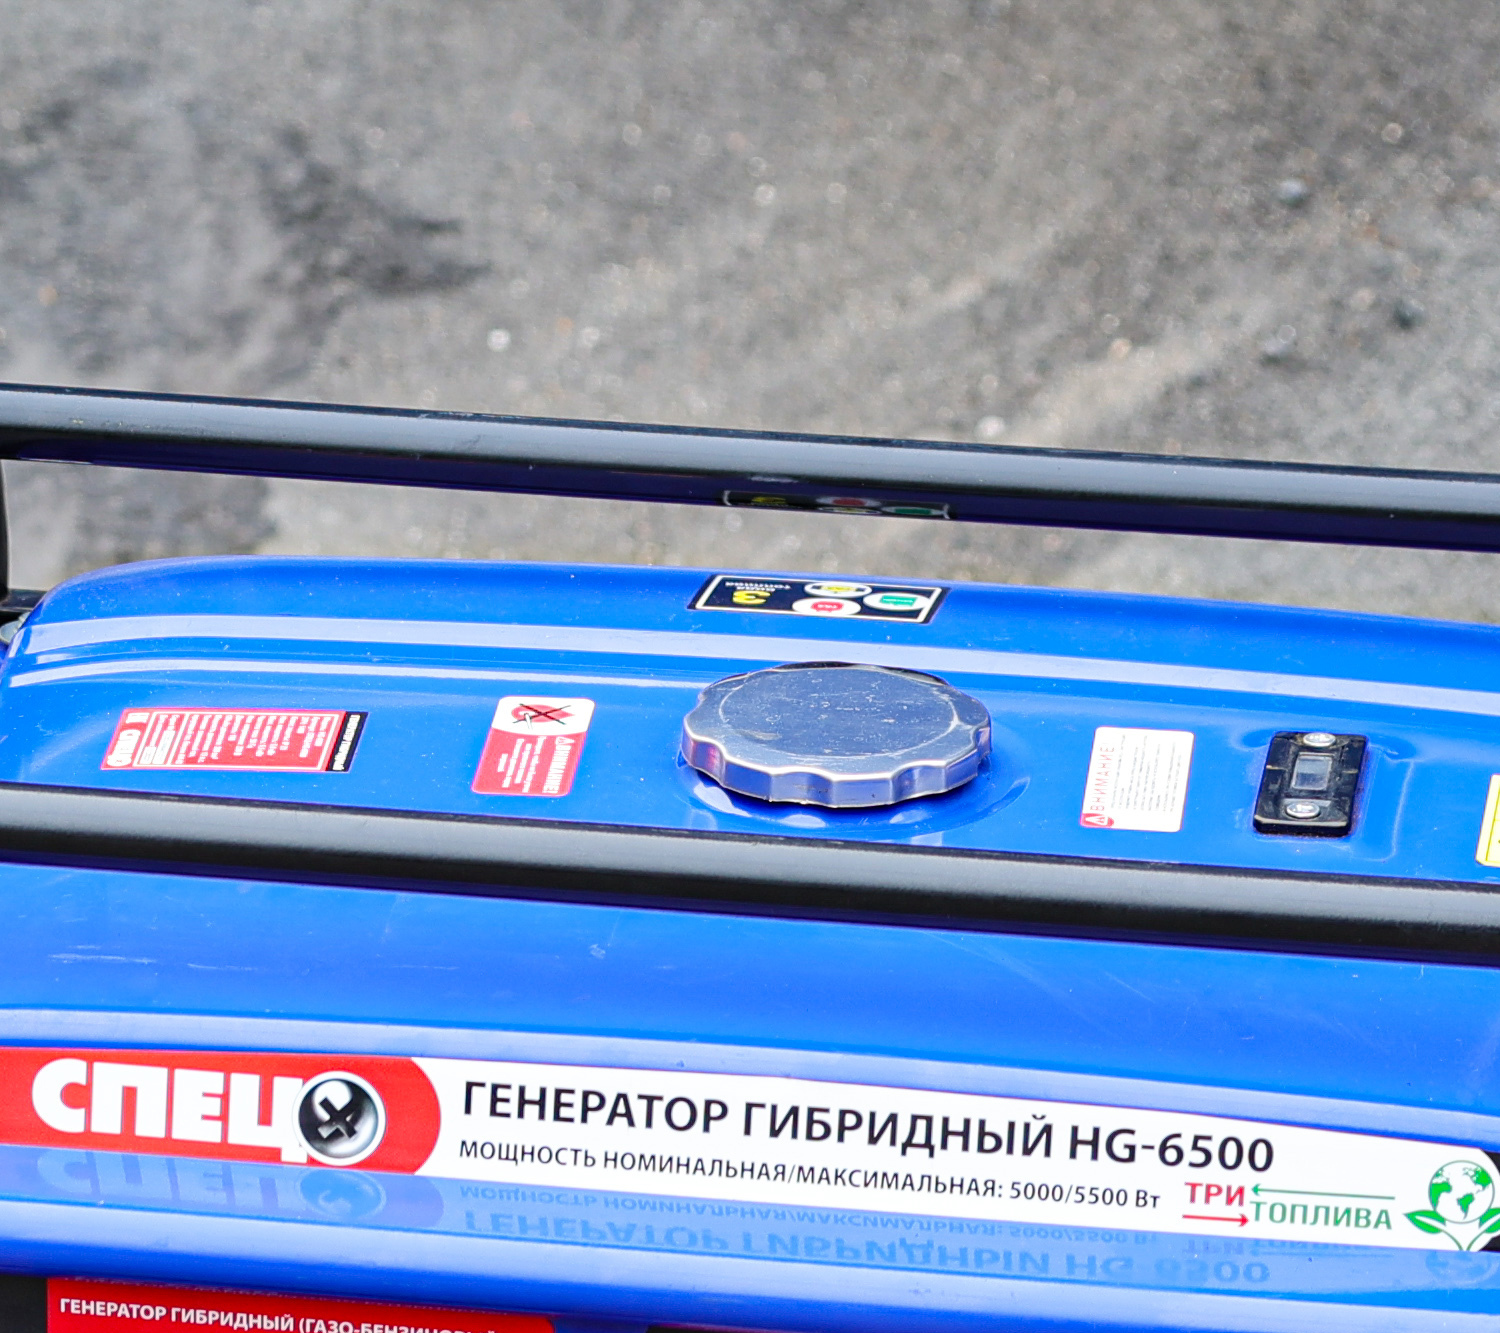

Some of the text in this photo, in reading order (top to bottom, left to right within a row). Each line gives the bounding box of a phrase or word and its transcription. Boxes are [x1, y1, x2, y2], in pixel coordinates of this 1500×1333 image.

[463, 1081, 1275, 1172] ГЕНЕРАТОР ГИБРИДНЫЙ HG-6500
[460, 1140, 1162, 1209] МОЩНОСТЬ НОМИНАЛЬНАЯ/МАКСИМАЛЬНАЯ: 5000/5500 Вт
[1184, 1182, 1246, 1207] ТРИ
[1250, 1199, 1394, 1231] ТОПЛИВА
[60, 1298, 167, 1321] ГЕНЕРАТОР
[171, 1306, 294, 1333] ГИБРИДНЫЙ
